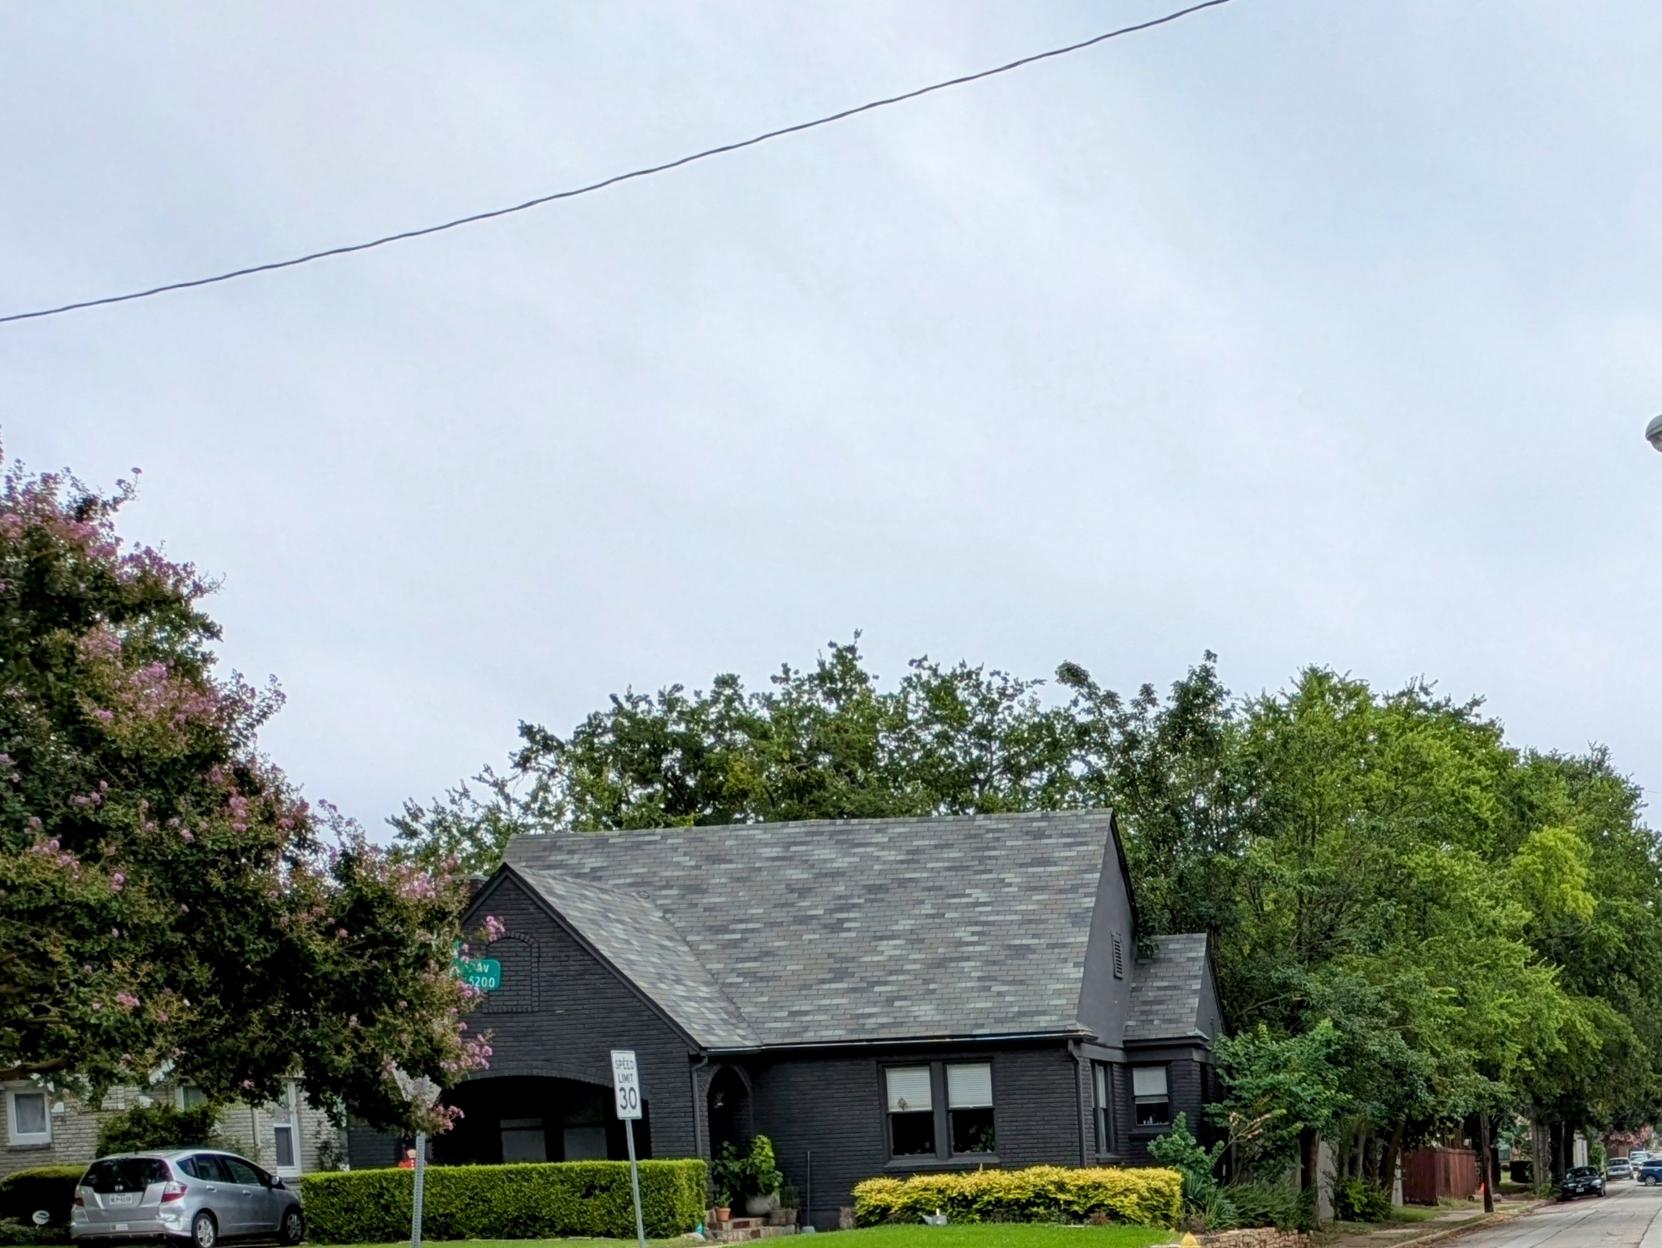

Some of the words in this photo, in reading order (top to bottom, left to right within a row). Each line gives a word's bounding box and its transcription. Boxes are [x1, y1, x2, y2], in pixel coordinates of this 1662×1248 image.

[615, 1059, 635, 1070] SPEED
[617, 1073, 634, 1084] LIMIT
[619, 1086, 638, 1110] 30
